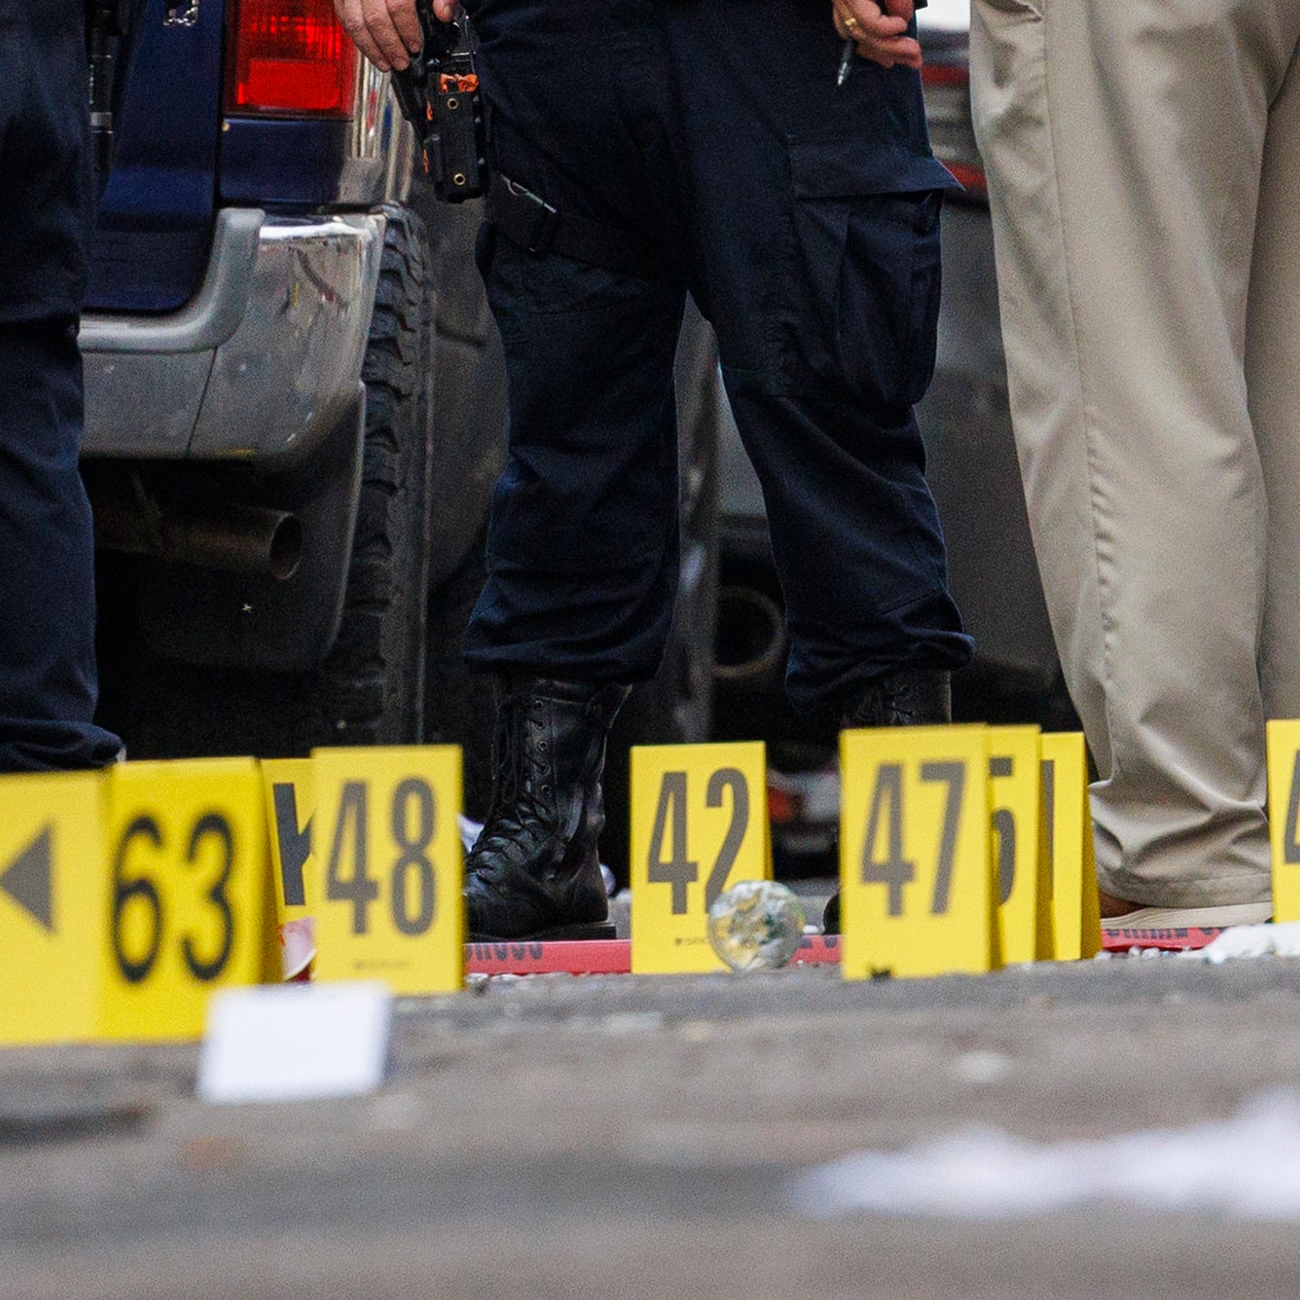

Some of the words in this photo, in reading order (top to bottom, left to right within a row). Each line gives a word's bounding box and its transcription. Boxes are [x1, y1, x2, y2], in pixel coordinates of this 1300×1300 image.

[111, 809, 236, 984] 63
[326, 776, 437, 936] 48
[646, 767, 751, 916] 42
[861, 760, 966, 918] 47
